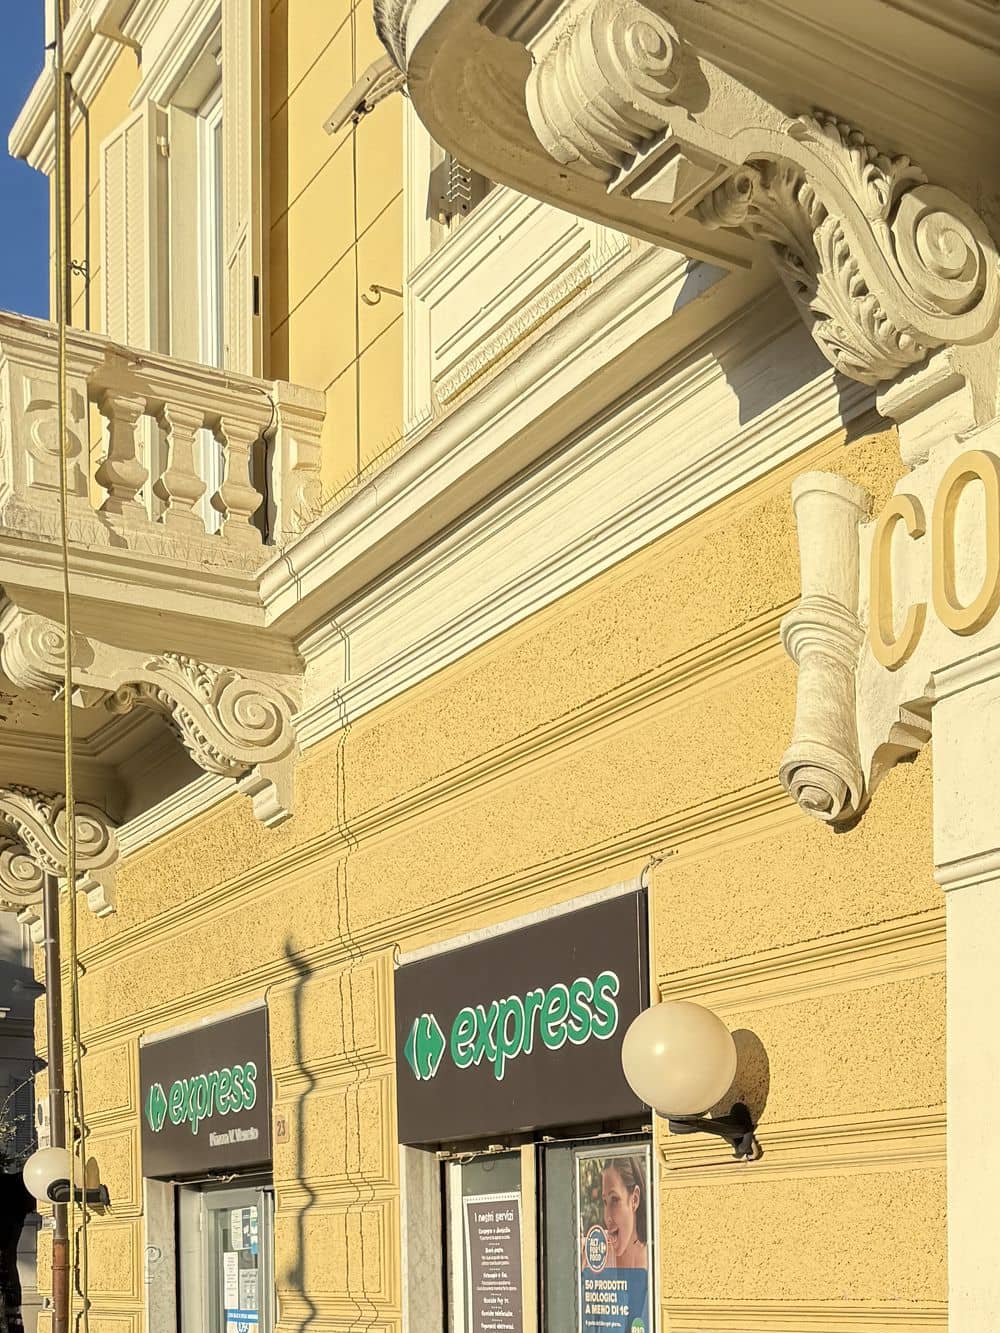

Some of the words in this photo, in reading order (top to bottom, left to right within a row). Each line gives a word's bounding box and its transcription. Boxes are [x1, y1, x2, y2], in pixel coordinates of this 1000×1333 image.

[451, 970, 619, 1081] express
[168, 1061, 257, 1135] express
[276, 1120, 287, 1137] 23
[584, 1280, 594, 1291] 50
[594, 1280, 628, 1291] PRODOTTI
[584, 1291, 618, 1304] BIOLOGICI
[584, 1304, 592, 1315] A
[591, 1304, 610, 1316] MENO
[610, 1305, 620, 1316] DI
